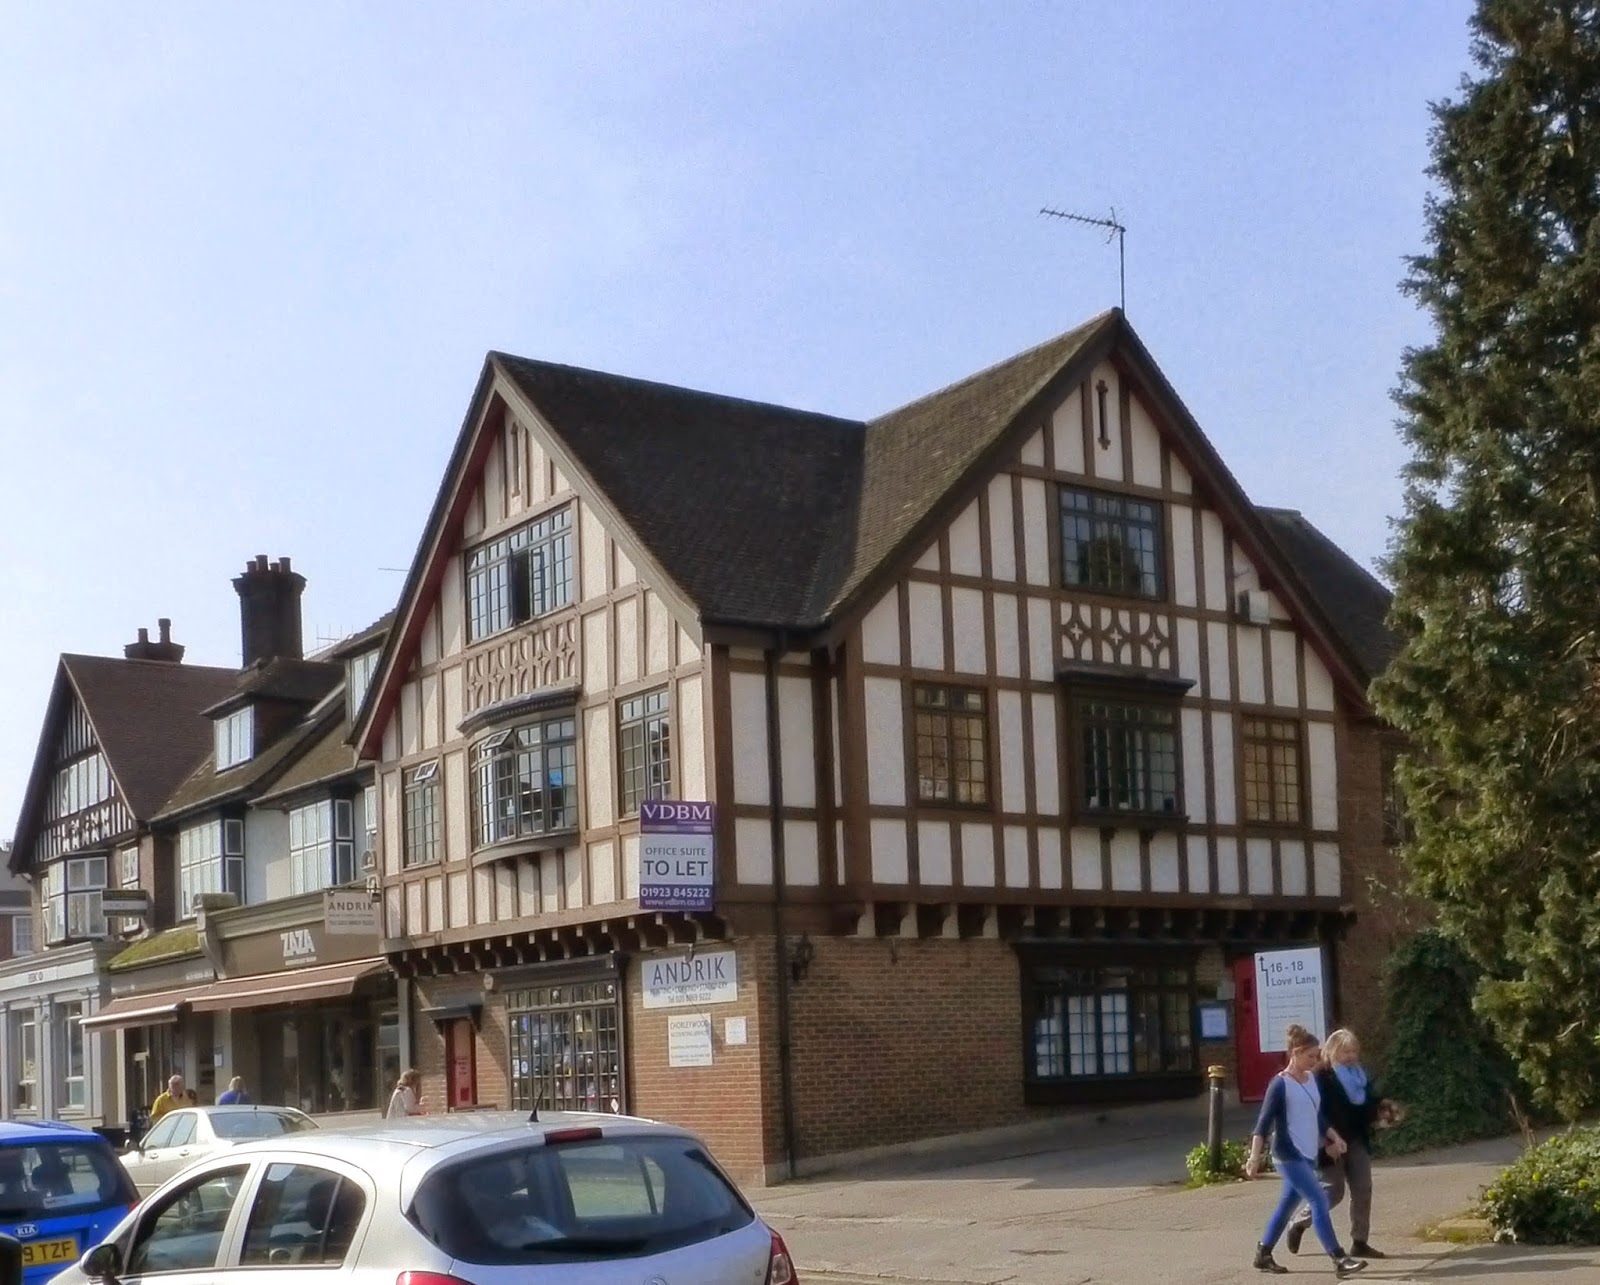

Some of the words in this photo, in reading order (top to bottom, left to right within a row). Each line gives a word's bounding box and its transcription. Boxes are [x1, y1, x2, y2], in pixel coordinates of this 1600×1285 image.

[642, 804, 711, 820] VDBM
[645, 847, 677, 856] OFFICE
[680, 847, 706, 856] SUITE
[643, 860, 670, 876] TO
[676, 860, 709, 876] LET
[640, 887, 671, 897] 01923
[673, 887, 710, 898] 845222
[328, 901, 374, 911] ANDRIK
[280, 928, 316, 957] ZAZA
[653, 956, 725, 985] ANDRIK
[1270, 962, 1283, 973] 16
[1290, 961, 1304, 972] 18
[1271, 977, 1292, 987] Love
[1295, 975, 1317, 985] Lane
[17, 1227, 36, 1235] KIA
[39, 1241, 72, 1261] TZF
